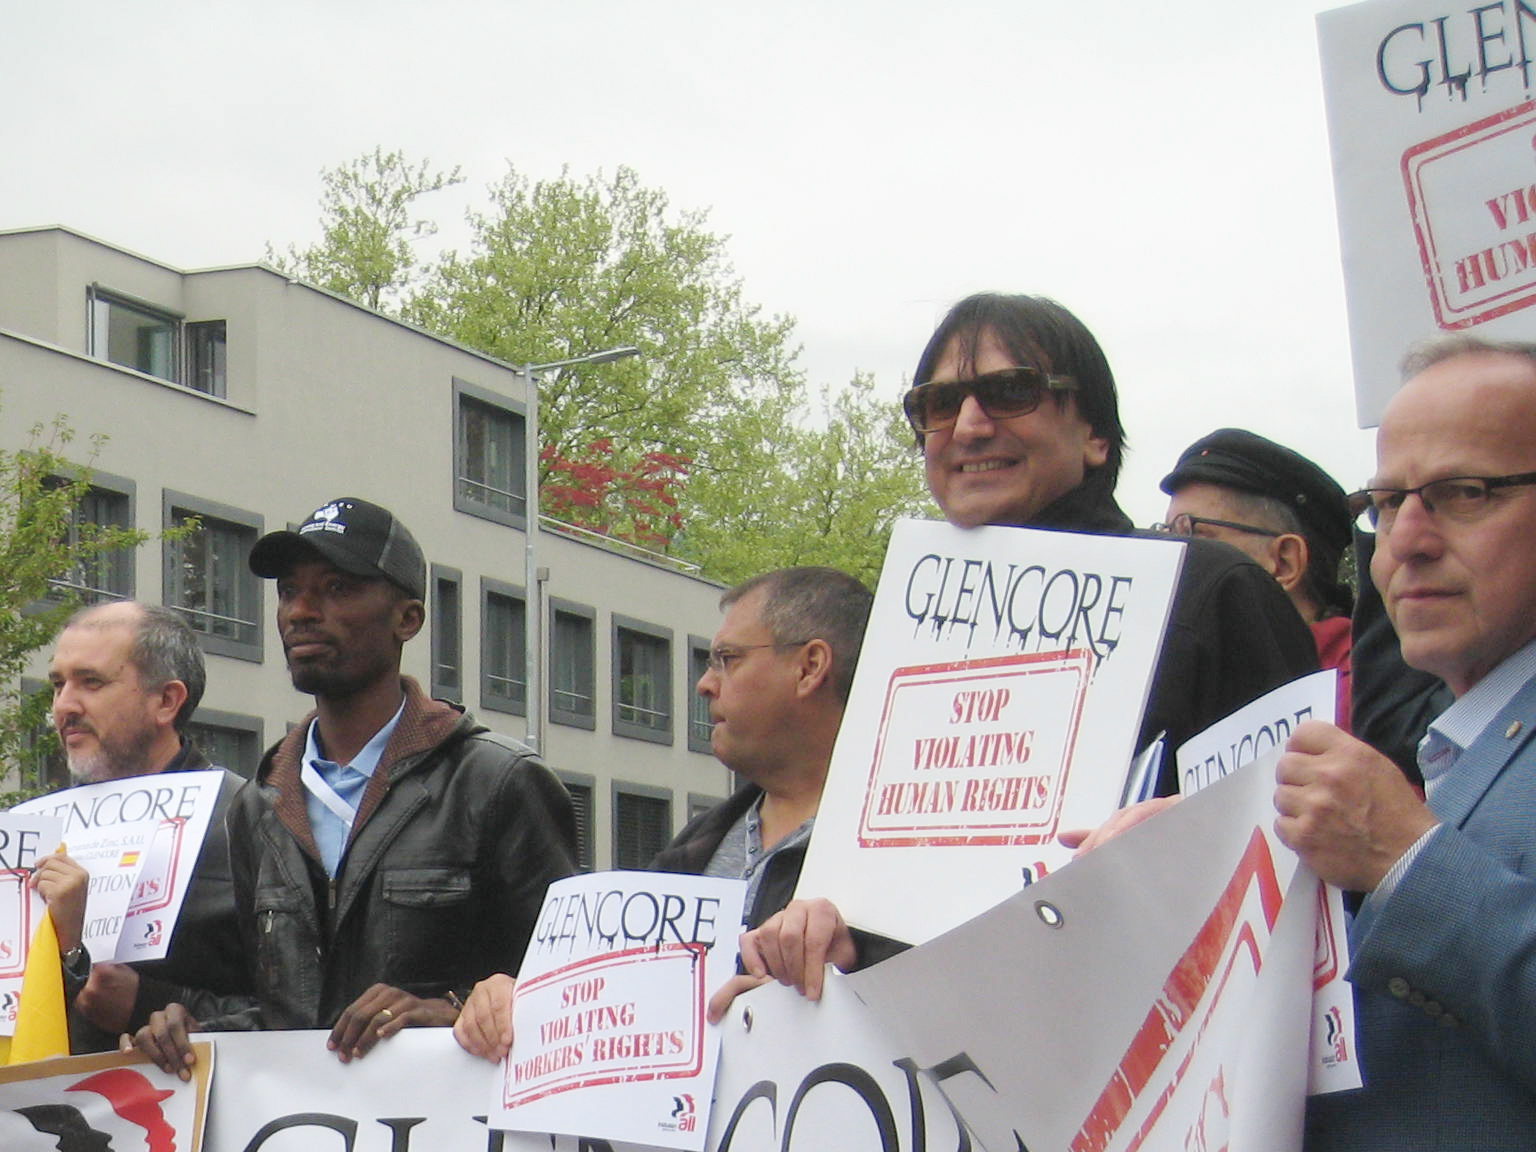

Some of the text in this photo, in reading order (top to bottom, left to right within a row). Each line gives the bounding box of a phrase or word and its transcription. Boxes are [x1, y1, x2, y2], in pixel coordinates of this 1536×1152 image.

[905, 554, 1133, 657] GLENCORE
[949, 688, 1010, 724] STOP
[914, 730, 1035, 770] VIOLATING
[30, 785, 201, 832] NCORE
[877, 775, 1051, 815] HUMAN RIGHTS
[536, 890, 720, 953] GLENCORE
[561, 977, 605, 1009] STOP
[540, 1002, 635, 1046] VIOLATING
[515, 1030, 684, 1085] WORKERS' RIGHTS
